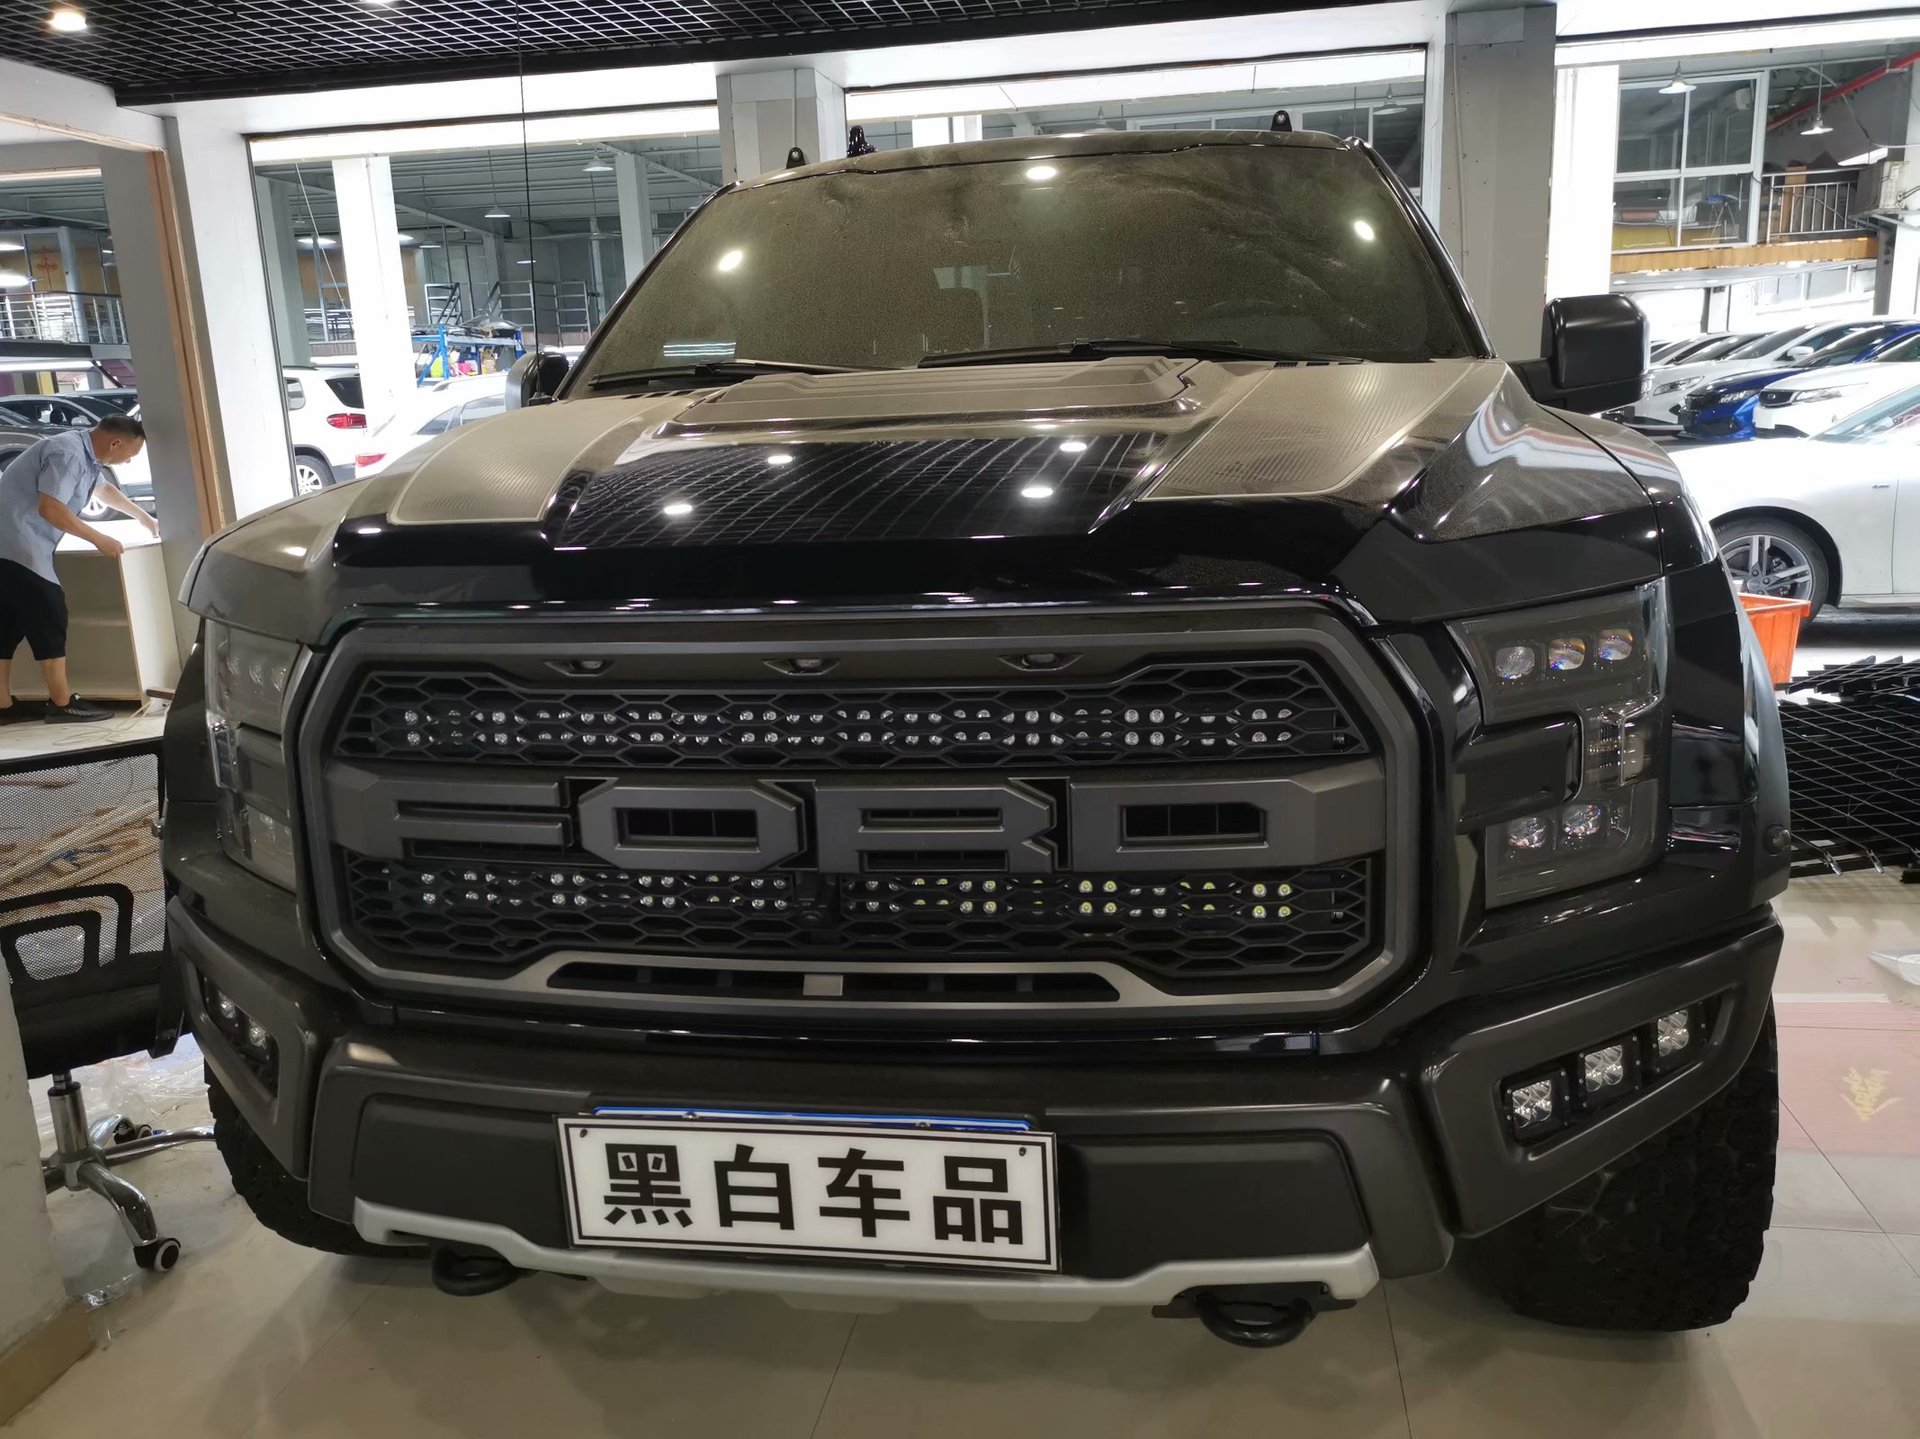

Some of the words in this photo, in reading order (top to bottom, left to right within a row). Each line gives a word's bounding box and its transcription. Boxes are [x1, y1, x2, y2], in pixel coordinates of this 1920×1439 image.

[331, 766, 1386, 873] FORD
[603, 1143, 1024, 1246] 黑白车品
